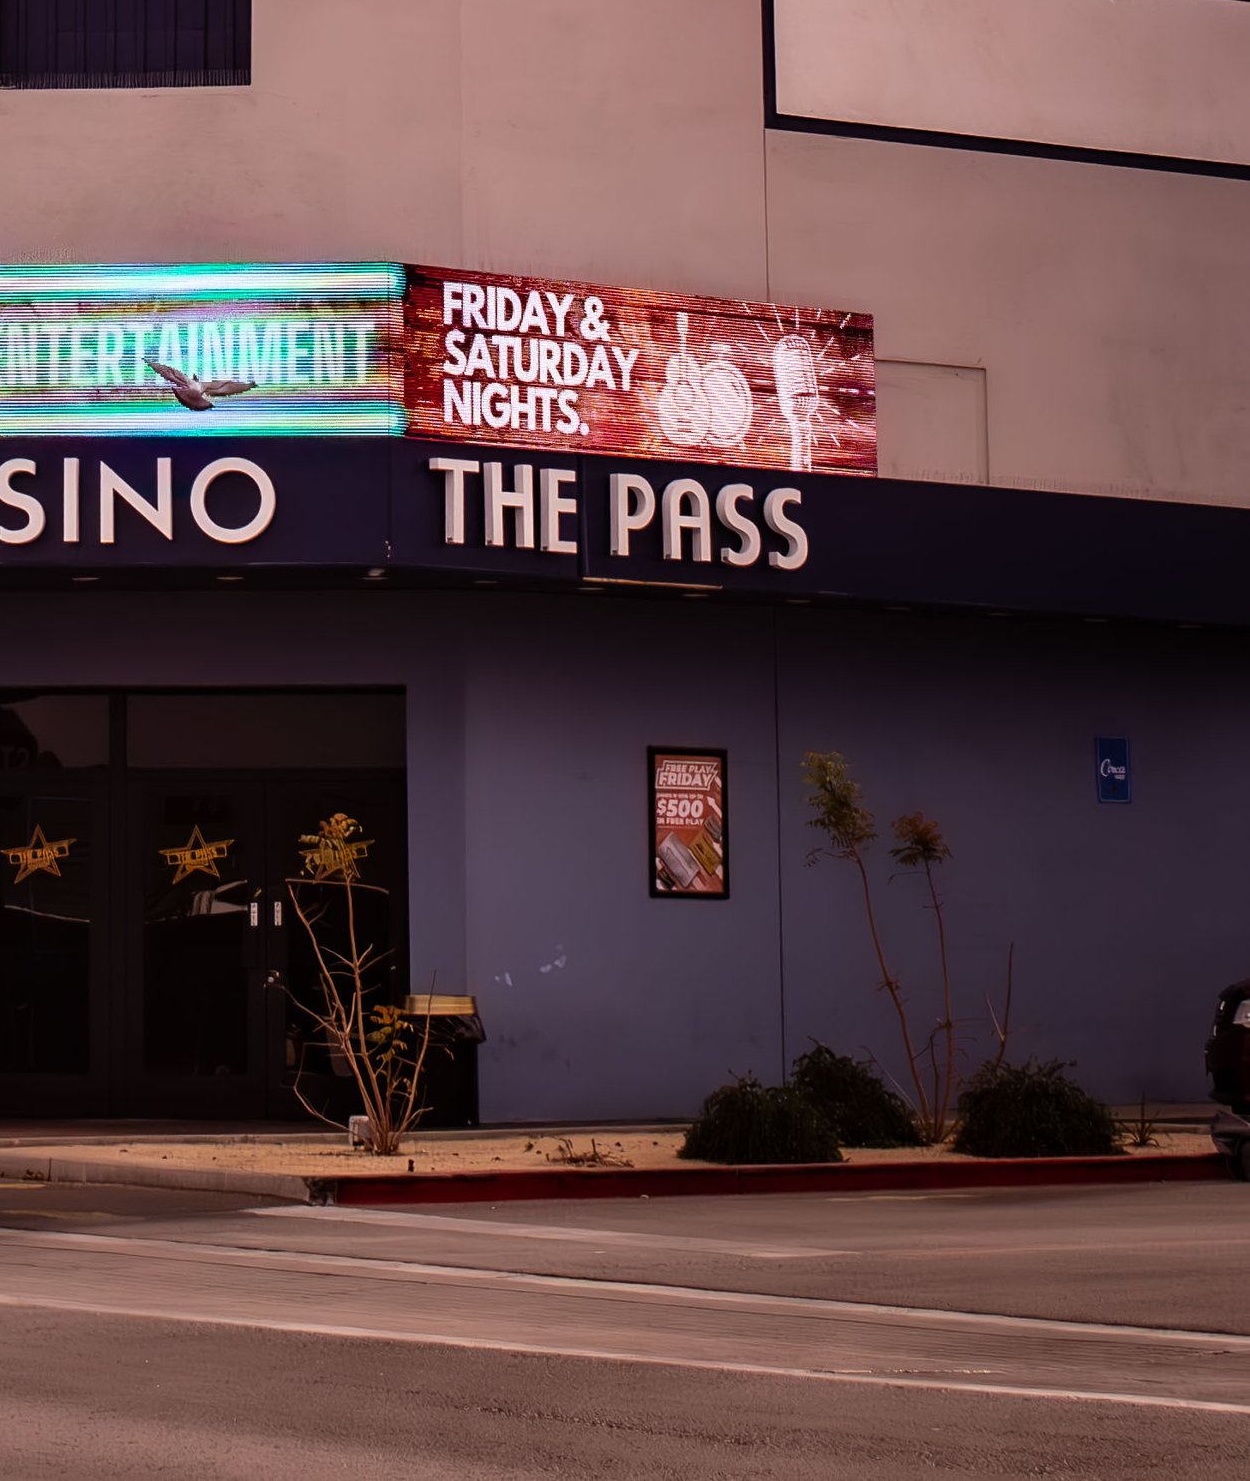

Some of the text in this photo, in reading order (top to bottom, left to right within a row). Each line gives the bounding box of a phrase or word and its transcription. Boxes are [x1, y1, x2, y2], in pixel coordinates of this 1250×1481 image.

[442, 281, 611, 342] FRIDAY &
[442, 328, 640, 393] SATURDAY
[442, 380, 590, 436] NIGHTS.
[429, 457, 810, 571] THE PASS
[658, 772, 711, 786] FRIDAY
[665, 764, 711, 774] FREE PLAY
[656, 797, 704, 818] $500
[685, 818, 704, 826] PLAY
